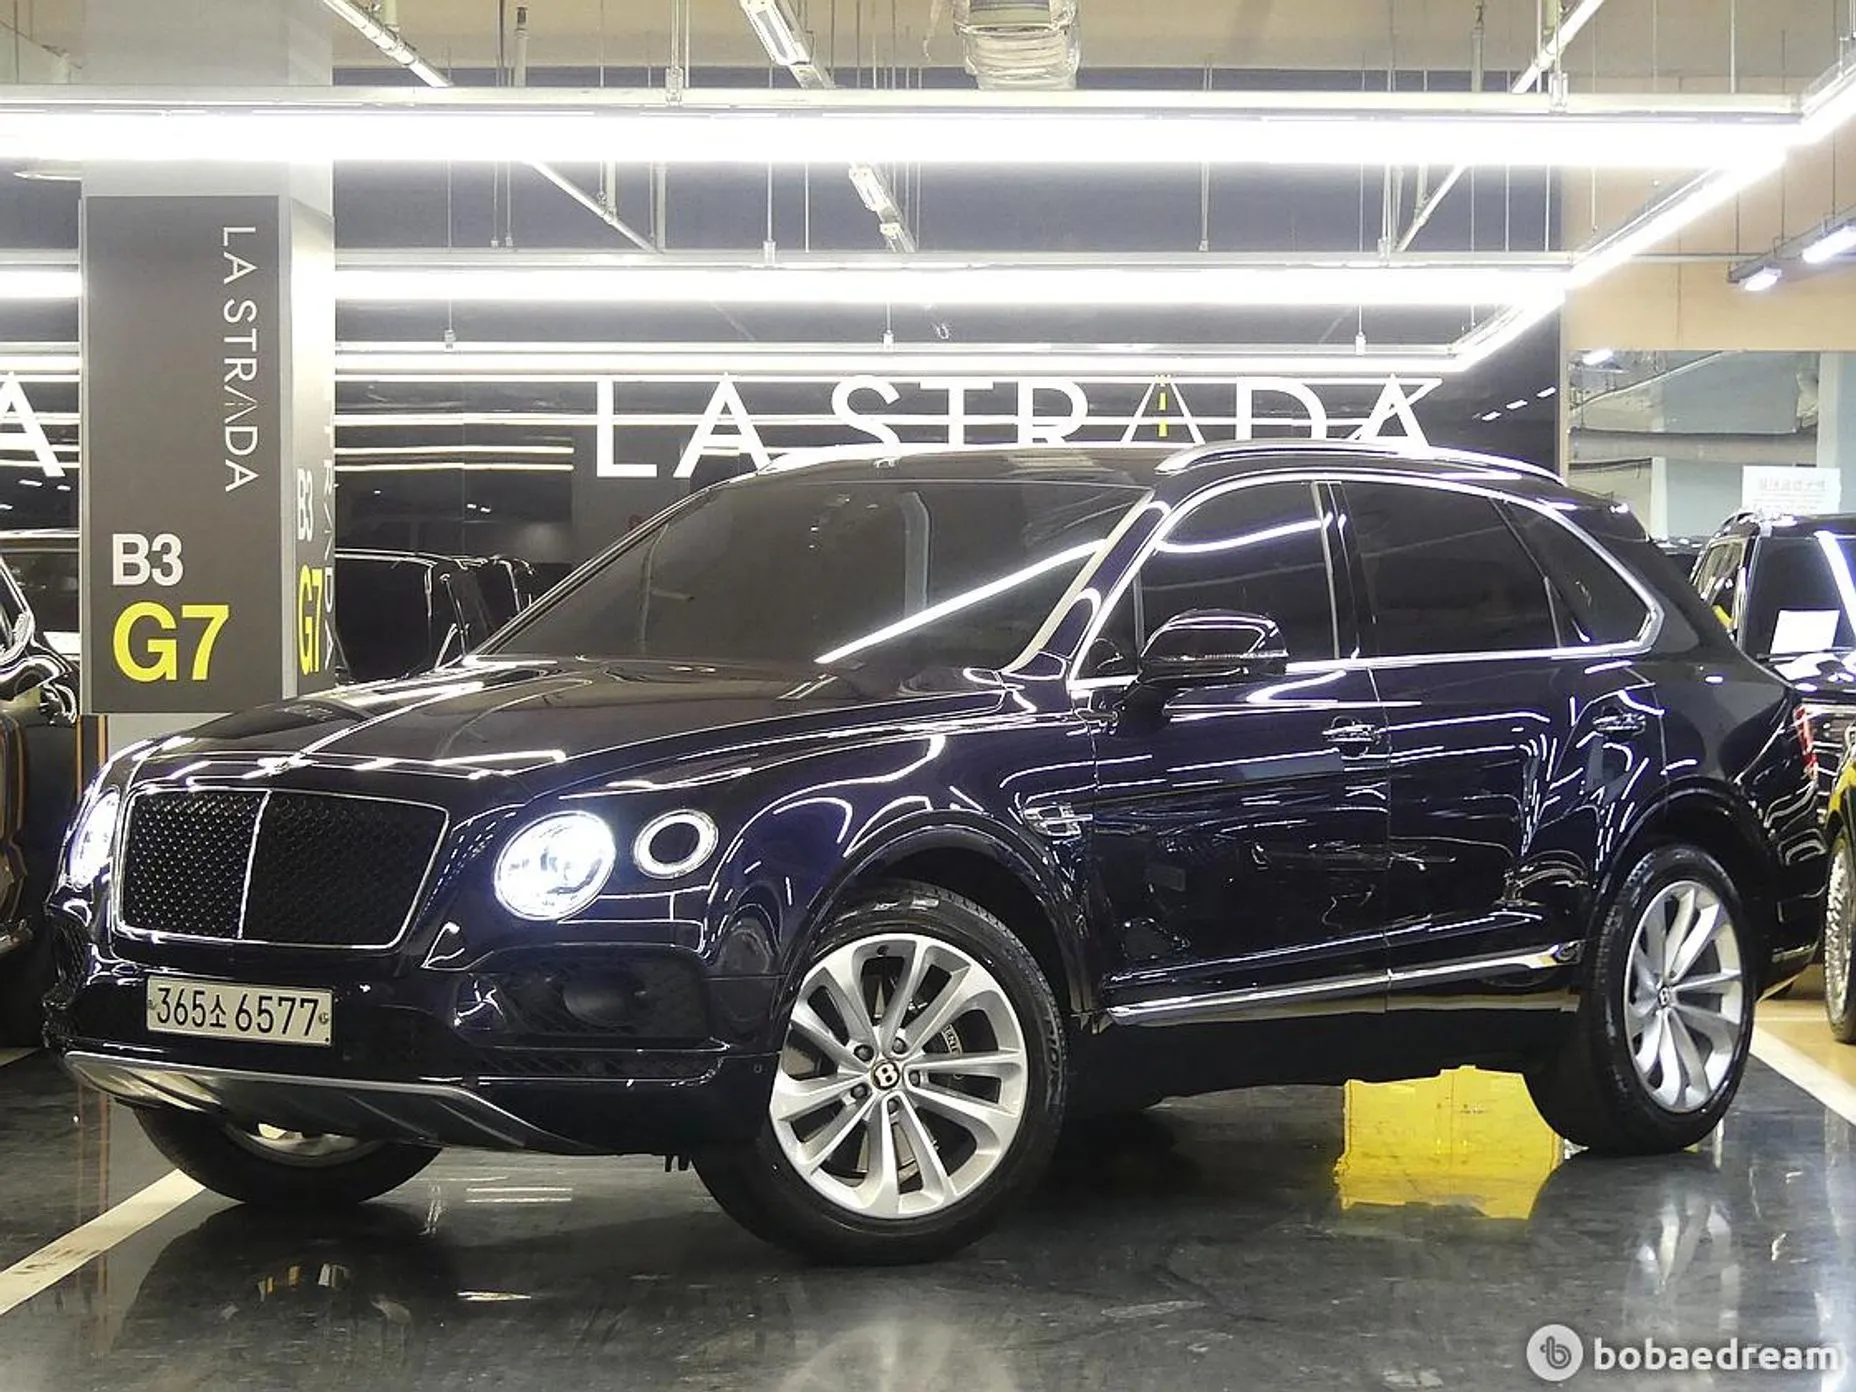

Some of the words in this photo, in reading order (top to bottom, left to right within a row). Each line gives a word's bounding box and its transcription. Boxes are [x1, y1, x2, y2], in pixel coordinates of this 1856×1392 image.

[223, 226, 257, 285] LA
[223, 298, 260, 492] STRADA
[597, 372, 772, 478] LA
[831, 373, 1430, 447] STRADA
[297, 468, 314, 542] B3
[112, 533, 184, 587] B3
[113, 602, 229, 682] G7
[298, 565, 323, 675] G7
[157, 986, 227, 1029] 365소
[235, 993, 319, 1037] 6577
[875, 1062, 899, 1087] B
